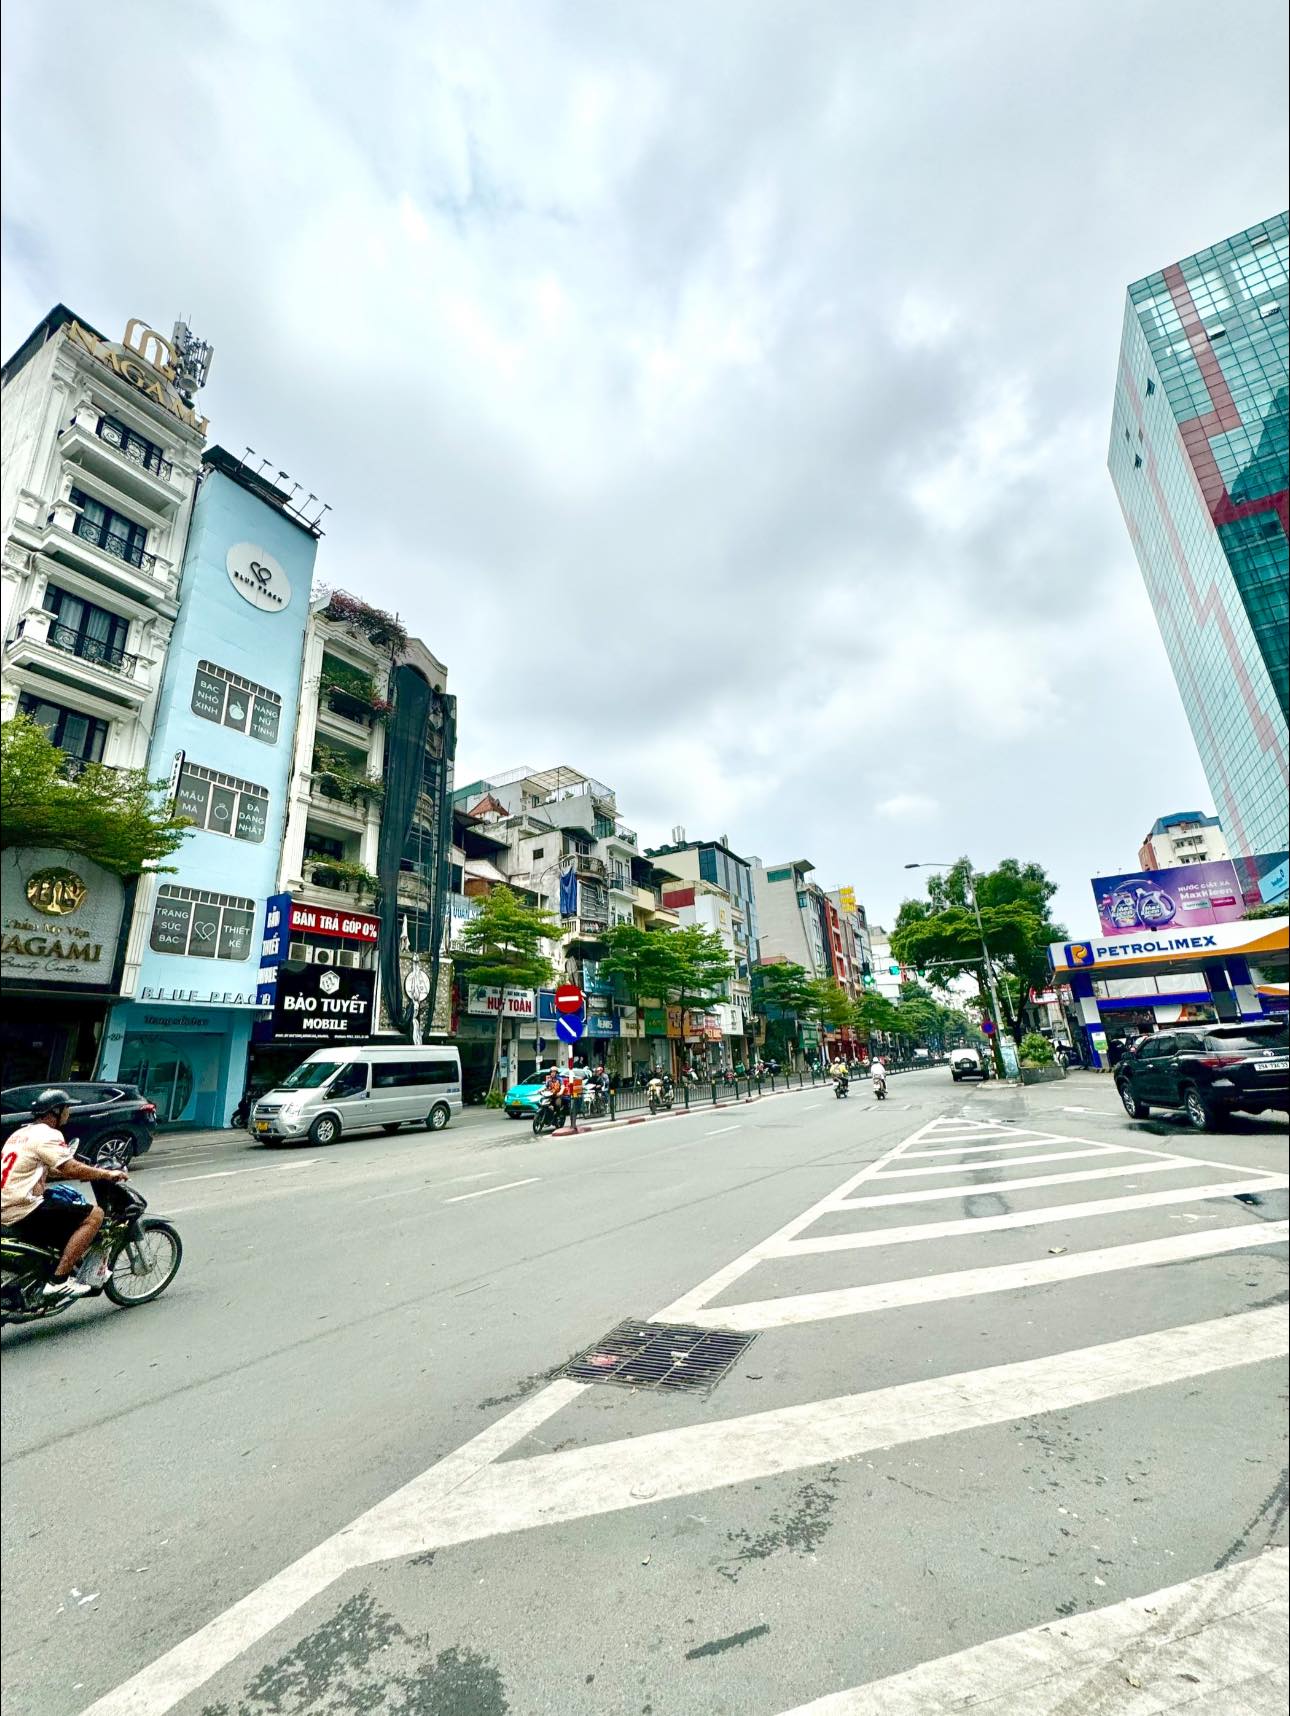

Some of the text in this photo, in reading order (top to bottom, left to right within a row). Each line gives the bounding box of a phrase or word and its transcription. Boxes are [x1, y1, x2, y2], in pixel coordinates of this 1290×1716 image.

[195, 701, 217, 715] XINH
[156, 907, 189, 919] TRANG
[292, 909, 377, 938] BÁN TRẢ GÓP 0%
[158, 934, 180, 945] BẠC
[1097, 936, 1217, 957] PETROLIMEX
[142, 986, 199, 1003] BLUE
[321, 994, 367, 1013] TUYẾT
[509, 998, 532, 1013] TOÀN
[303, 1018, 348, 1030] MOBILE
